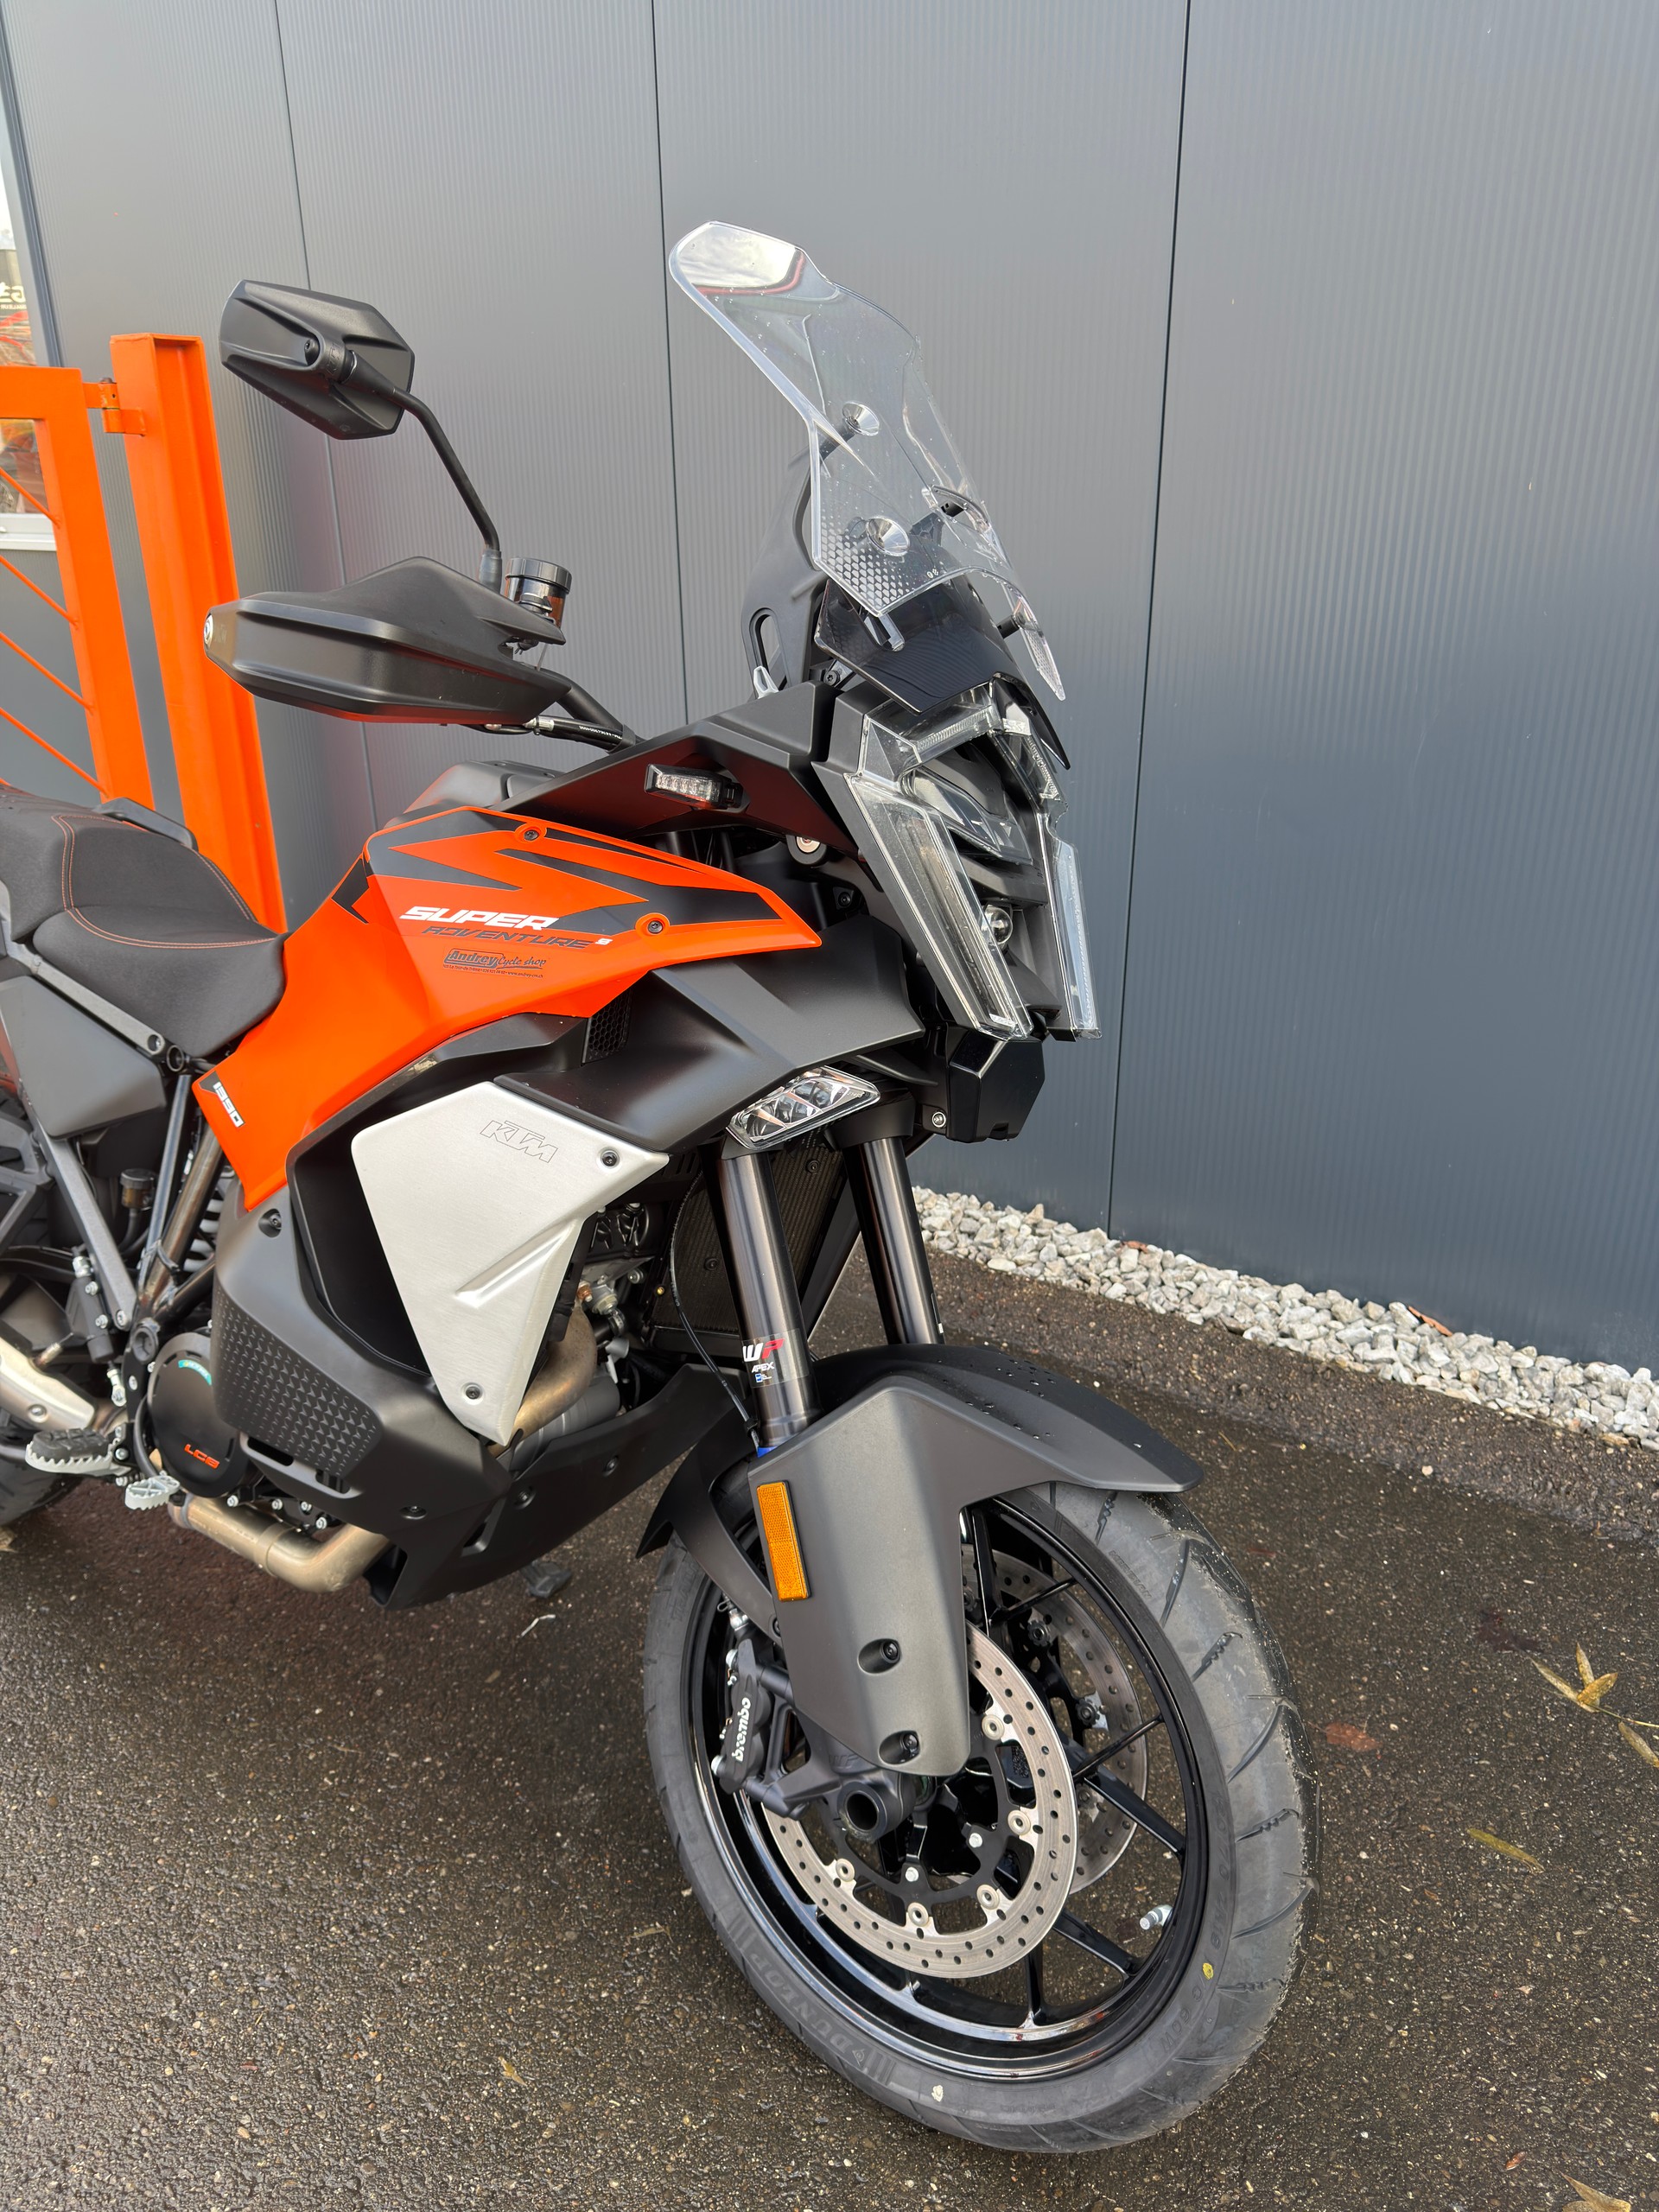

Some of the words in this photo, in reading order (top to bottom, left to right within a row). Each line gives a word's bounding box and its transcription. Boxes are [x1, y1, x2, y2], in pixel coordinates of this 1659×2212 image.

[399, 906, 560, 931] SUPER
[421, 926, 594, 949] ADVENTURE
[448, 950, 499, 967] Andrey
[497, 956, 522, 968] Cycle
[523, 956, 546, 967] shop
[213, 1081, 245, 1128] 1390
[480, 1120, 558, 1163] KTM
[742, 1338, 785, 1363] WP
[751, 1361, 775, 1373] APEX
[732, 1696, 752, 1762] brembo
[749, 1953, 855, 2055] DUNLOP
